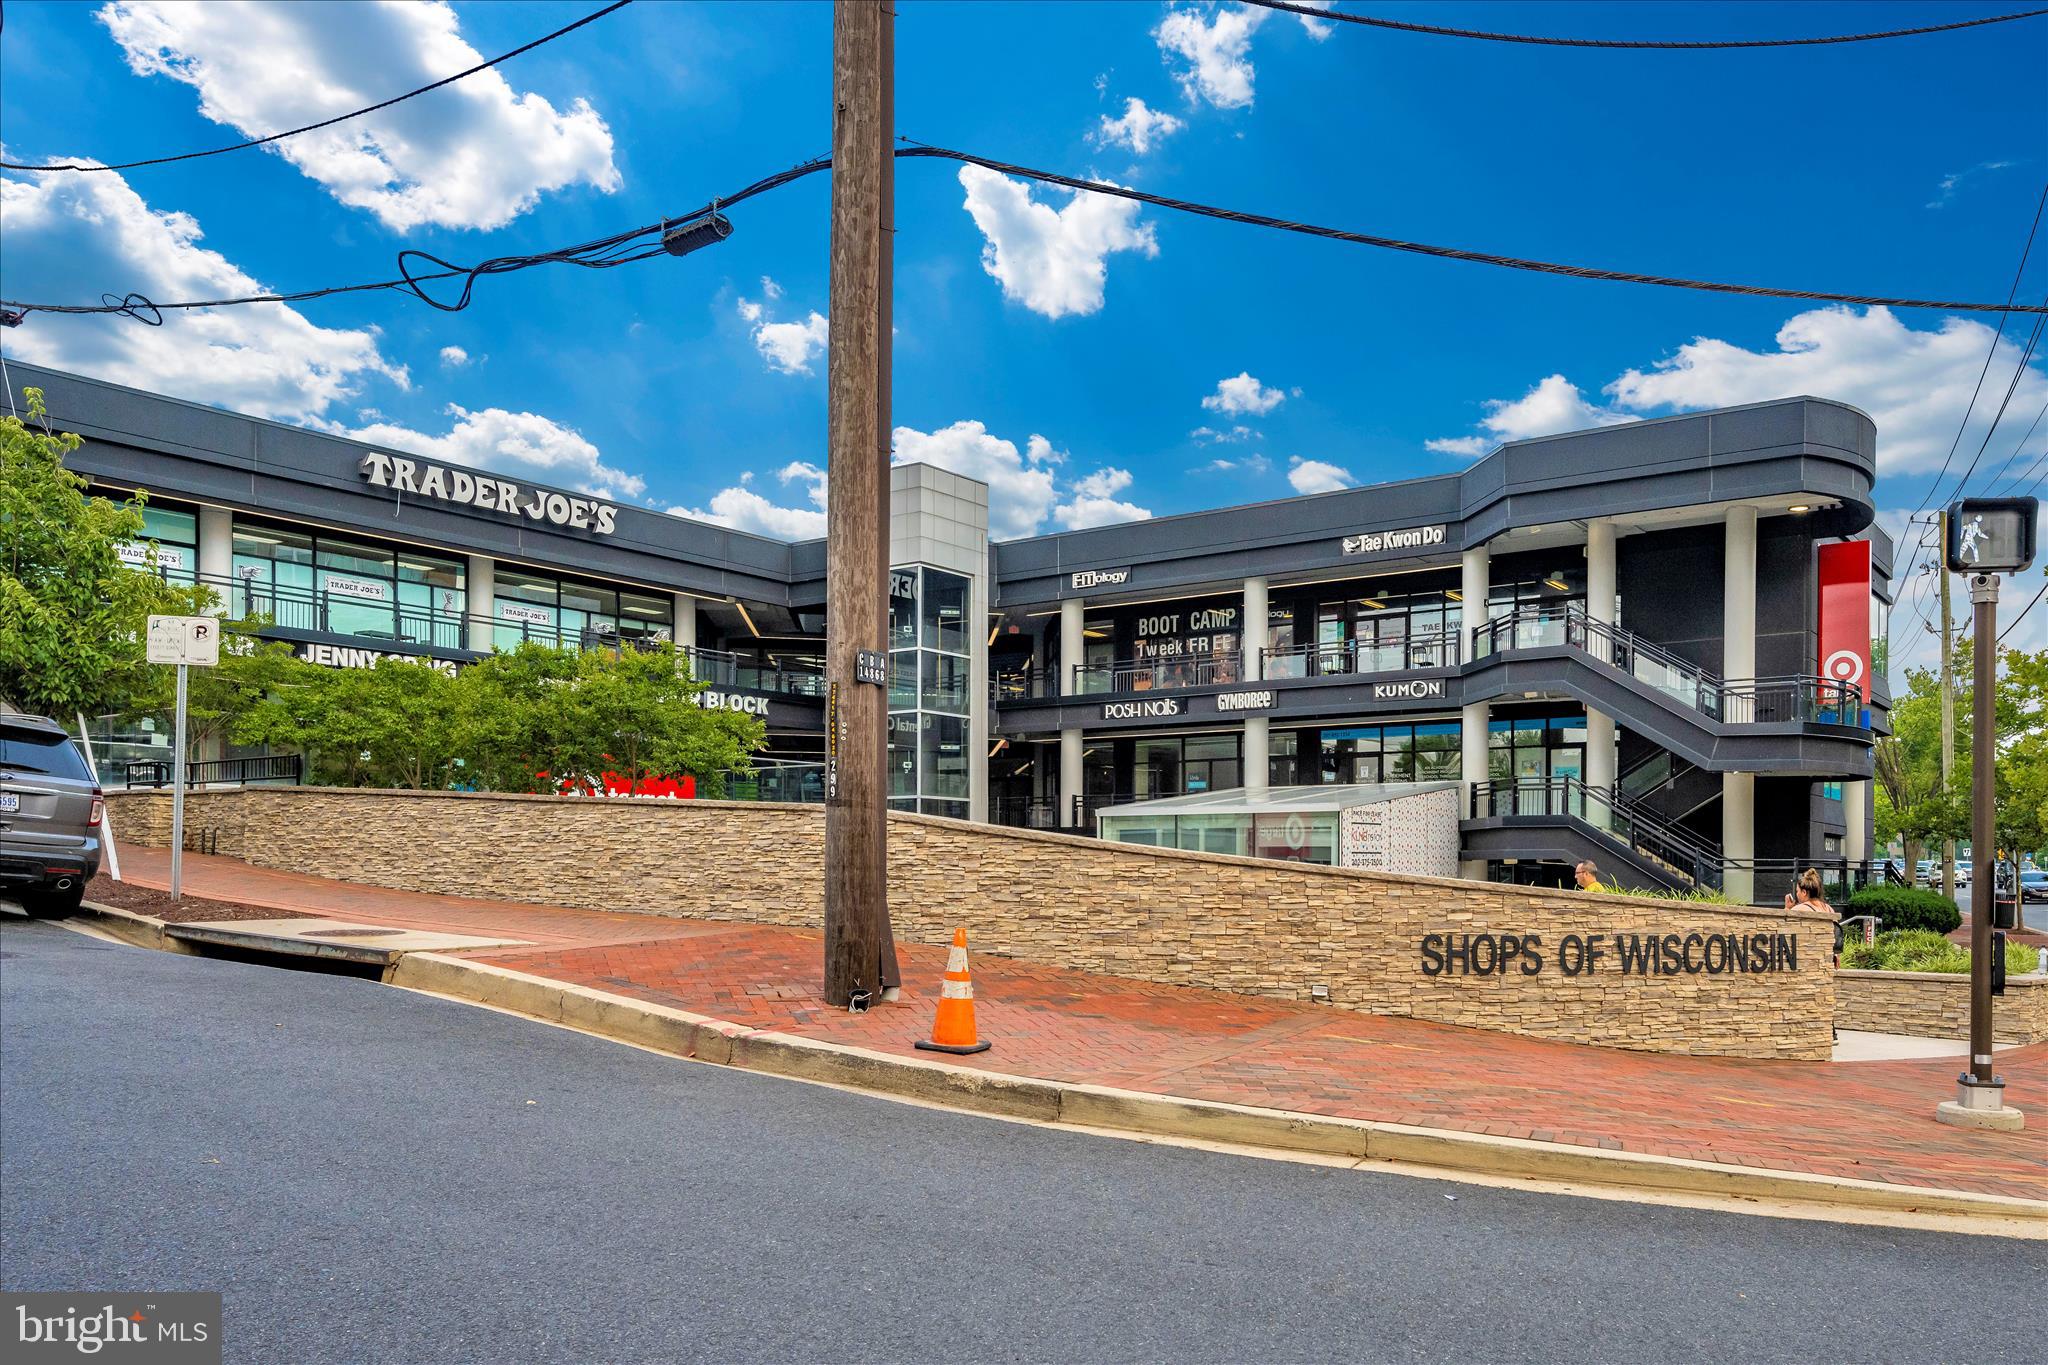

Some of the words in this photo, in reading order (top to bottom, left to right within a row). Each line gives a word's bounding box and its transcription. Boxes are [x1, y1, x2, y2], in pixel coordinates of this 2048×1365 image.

[364, 452, 521, 515] TRADER
[523, 490, 618, 534] JOE'S
[1359, 535, 1382, 552] Tae
[1383, 531, 1421, 549] Kwon
[1423, 526, 1443, 544] Do
[330, 581, 358, 591] TRADER
[360, 586, 380, 594] JOE'S
[1072, 571, 1127, 588] FITology
[505, 609, 528, 617] TRADER
[1139, 614, 1180, 636] BOOT
[1190, 608, 1236, 630] CAMP
[1422, 623, 1440, 632] TAE
[300, 643, 381, 669] JENNY
[880, 658, 885, 668] A
[859, 666, 885, 681] 14868
[1375, 680, 1440, 698] KUMON
[1105, 702, 1141, 718] POSH
[0, 797, 16, 806] 595
[1421, 933, 1543, 976] SHOPS
[1559, 933, 1605, 977] OF
[1617, 932, 1798, 974] WISCONSIN
